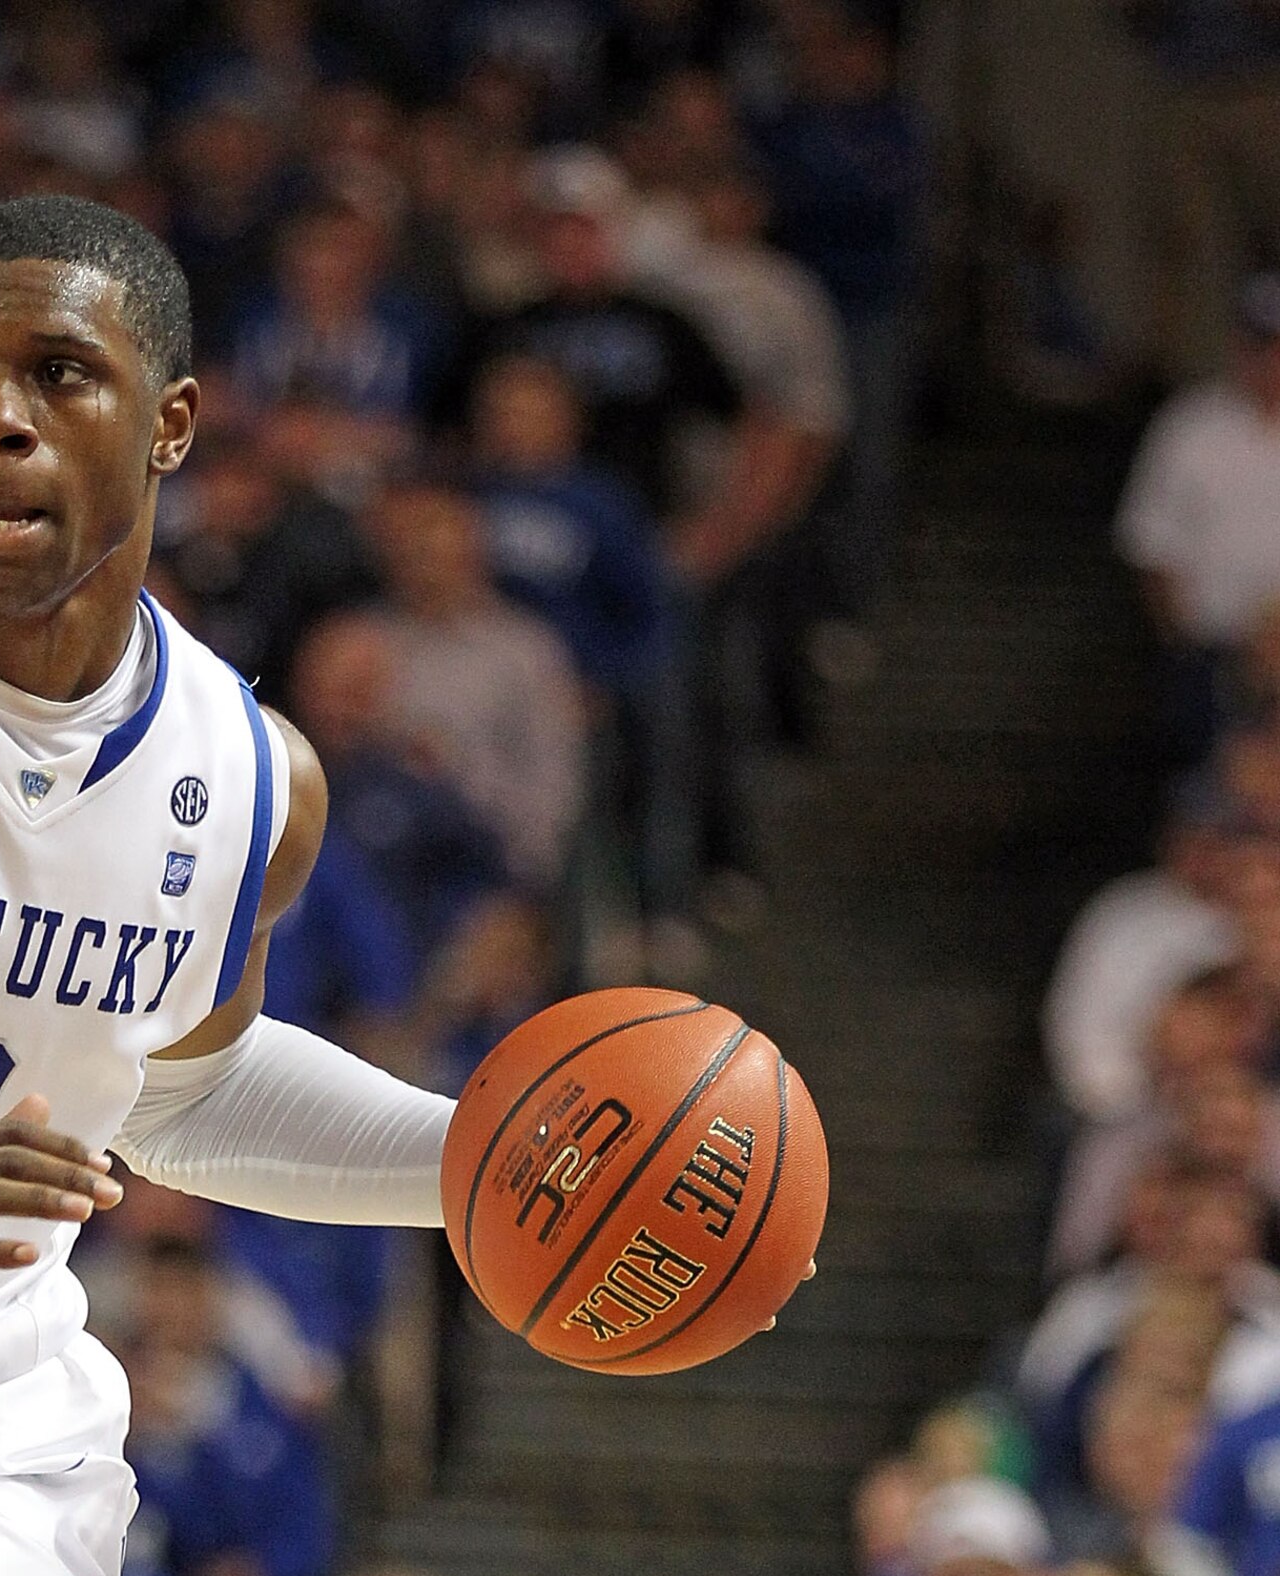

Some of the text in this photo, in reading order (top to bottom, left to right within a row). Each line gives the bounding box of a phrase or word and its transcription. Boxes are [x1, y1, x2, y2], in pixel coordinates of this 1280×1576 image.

[174, 779, 207, 823] SEC
[516, 1098, 632, 1245] C2C
[568, 1116, 755, 1342] THE ROCK
